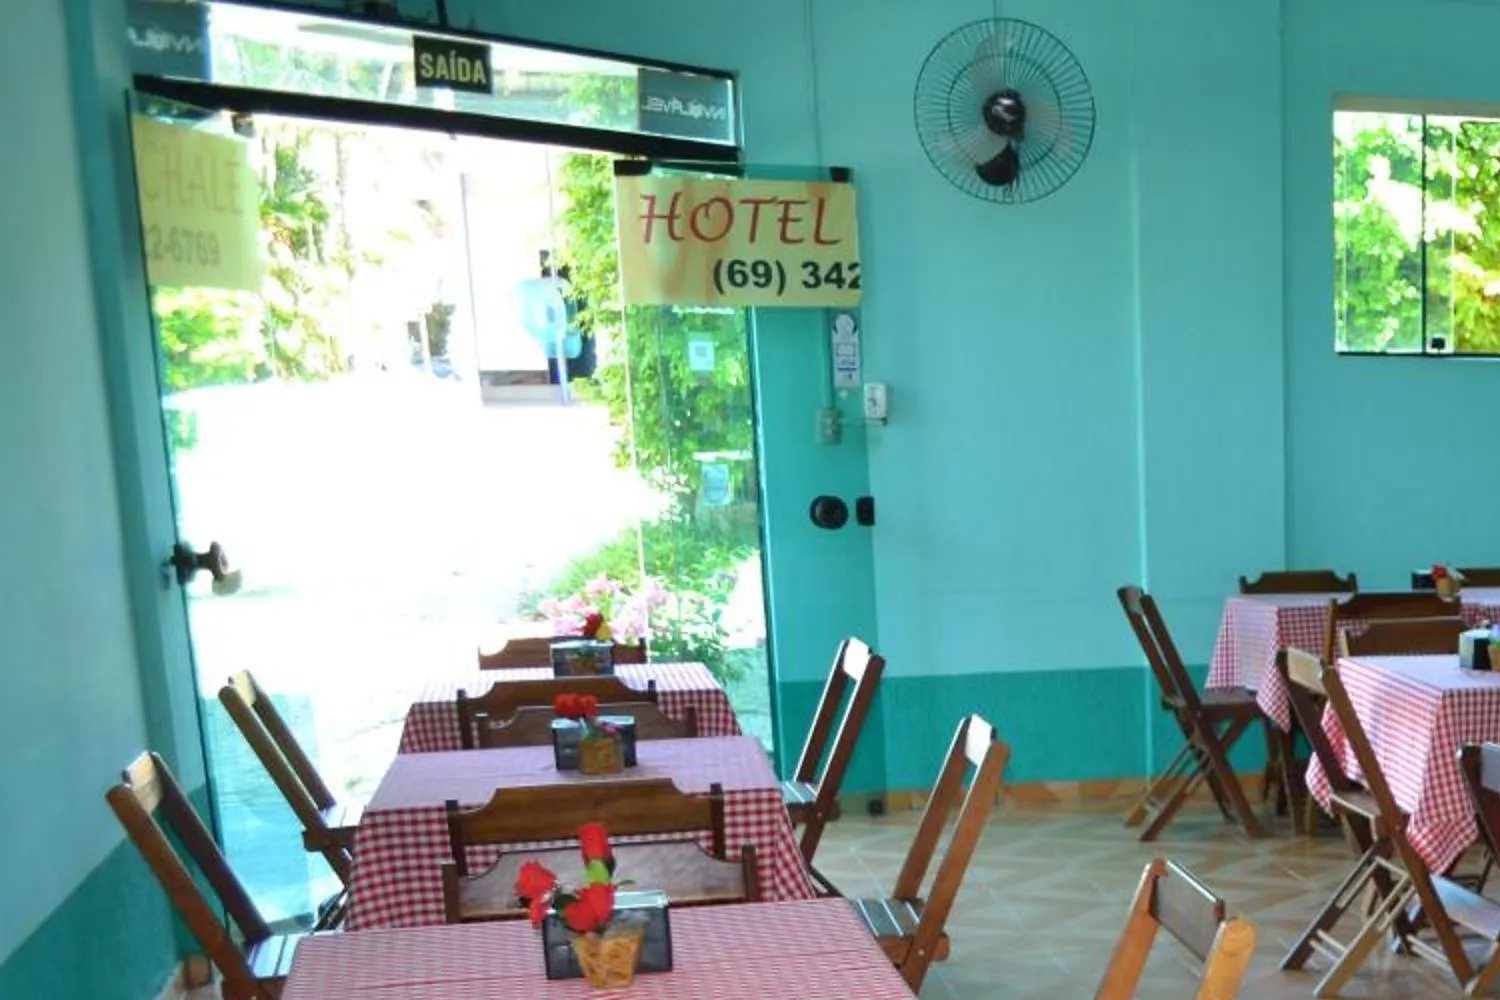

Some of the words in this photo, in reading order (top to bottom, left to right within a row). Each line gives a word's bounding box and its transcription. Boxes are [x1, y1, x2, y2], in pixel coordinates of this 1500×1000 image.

[420, 49, 487, 84] SAÍDA
[639, 191, 842, 246] HOTEL
[713, 259, 787, 297] (69)
